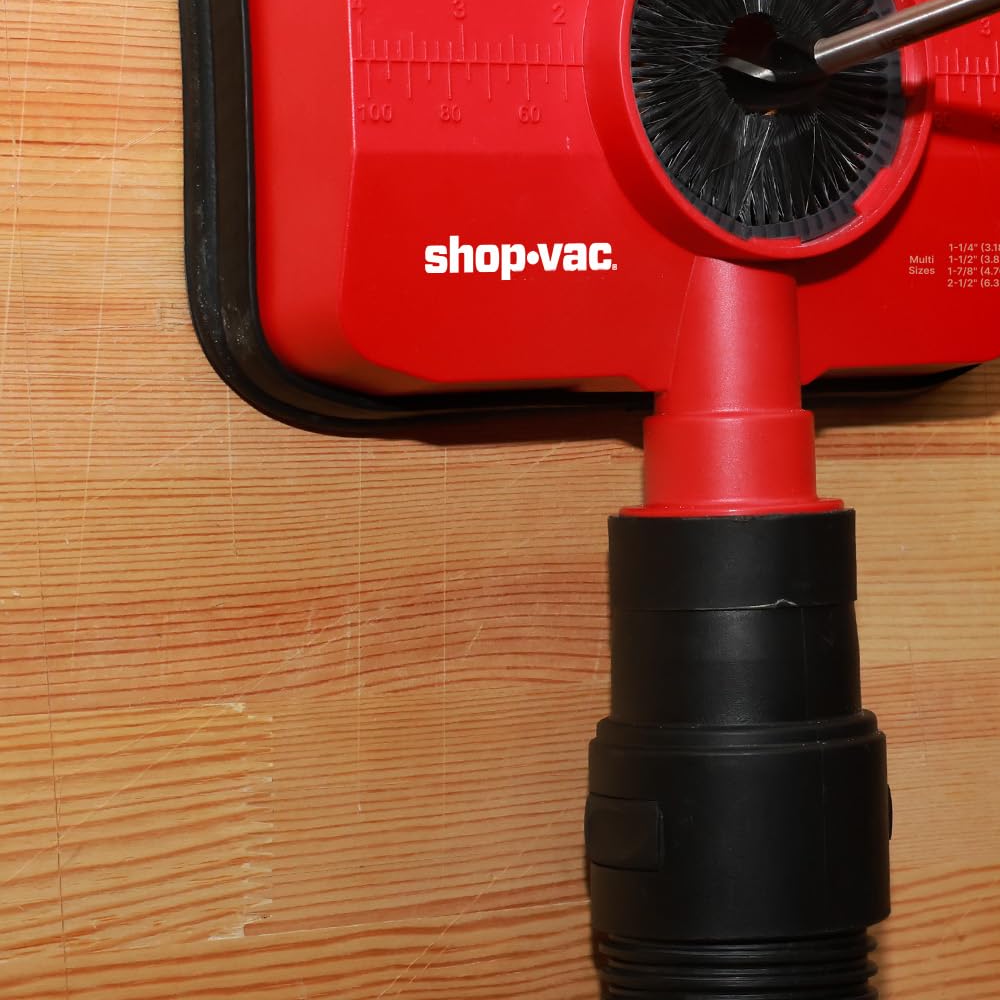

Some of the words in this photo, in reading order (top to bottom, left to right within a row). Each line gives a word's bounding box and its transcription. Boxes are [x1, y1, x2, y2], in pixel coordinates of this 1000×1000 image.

[552, 2, 567, 25] 2
[440, 104, 462, 122] 80
[518, 105, 541, 123] 60
[948, 243, 978, 252] 1-1/4"
[909, 255, 934, 264] Multi
[948, 255, 978, 264] 1-1/2"
[908, 266, 935, 275] Sizes
[947, 266, 978, 276] 1-7/8"
[947, 278, 978, 288] 2-1/2"
